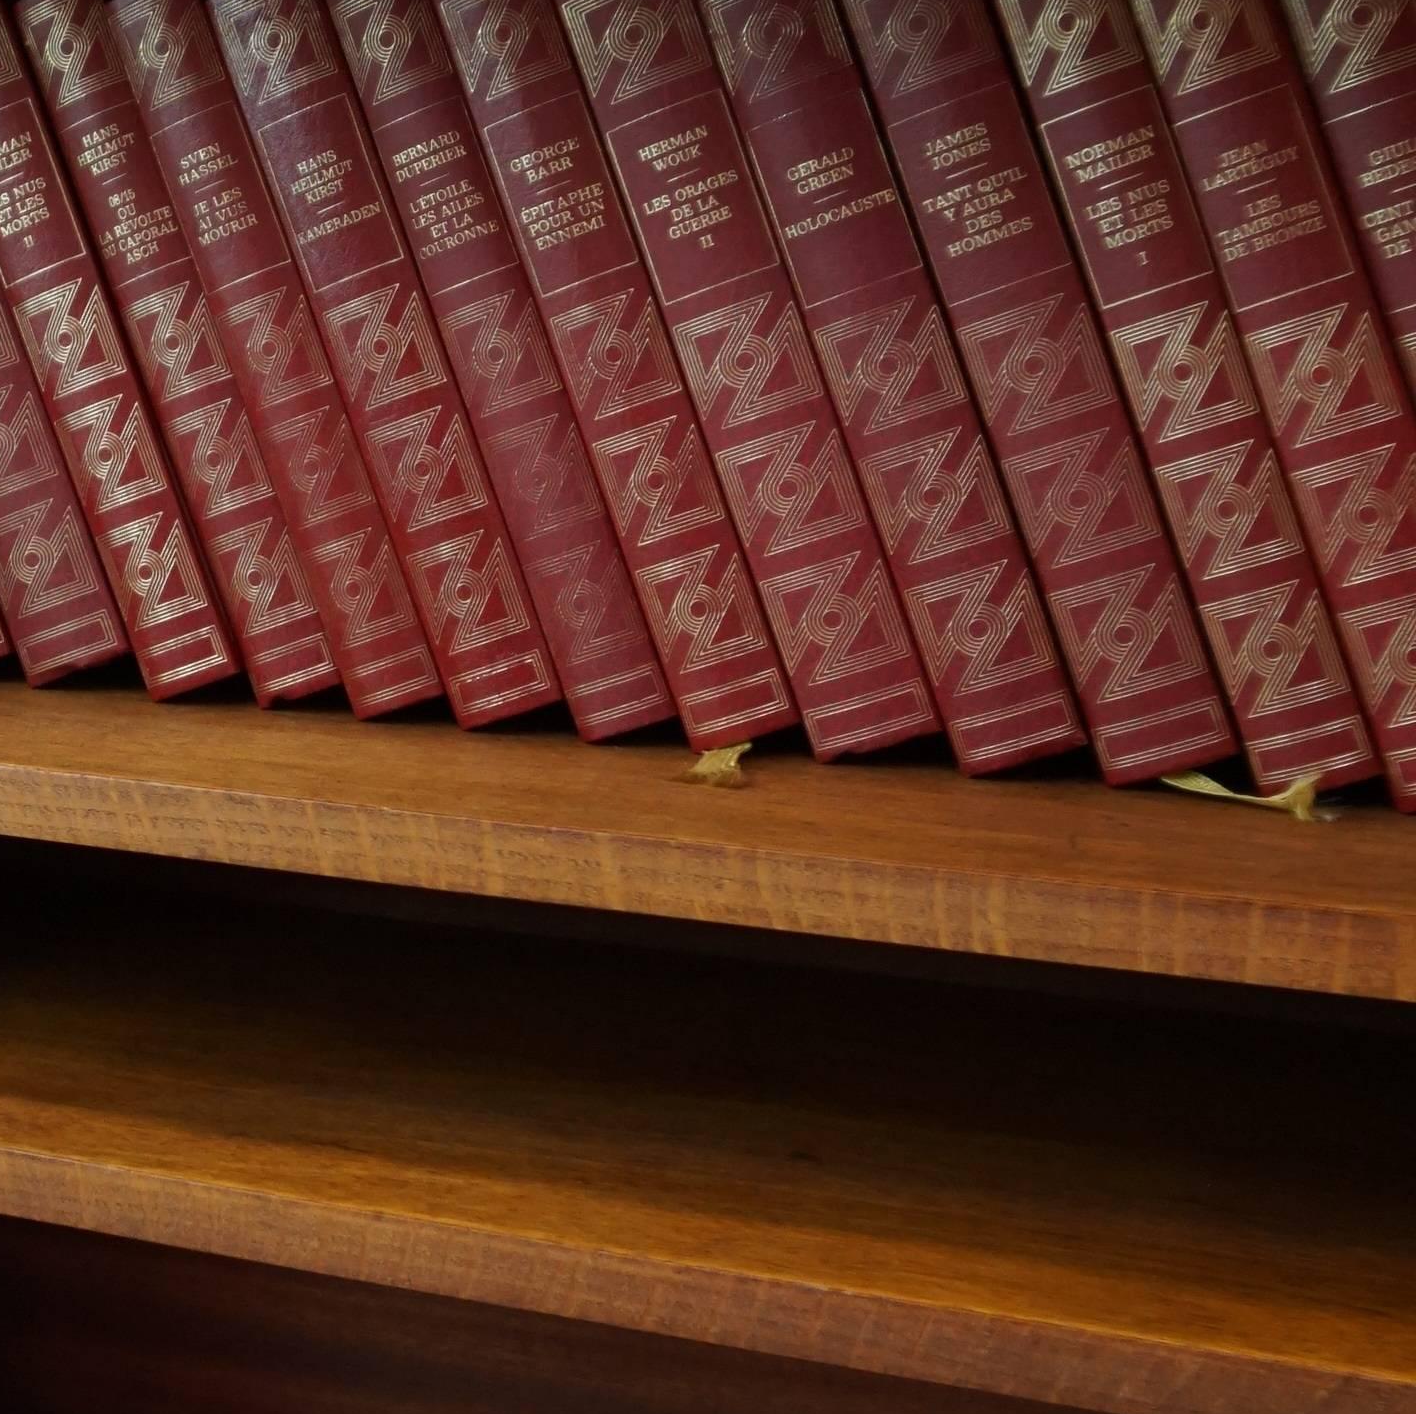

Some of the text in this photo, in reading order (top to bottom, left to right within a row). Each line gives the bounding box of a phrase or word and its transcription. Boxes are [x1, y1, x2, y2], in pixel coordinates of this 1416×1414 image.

[77, 132, 135, 167] HELLMUT
[82, 123, 120, 148] HANS
[392, 130, 460, 168] BERNARD
[638, 125, 708, 162] HERMAN
[925, 122, 988, 156] JAMES
[1064, 125, 1154, 169] NORMAN
[91, 150, 127, 175] KIRST
[180, 143, 221, 170] SVEN
[296, 149, 337, 175] HANS
[396, 145, 467, 184] DUPERIER
[510, 137, 580, 173] GEORGE
[526, 156, 573, 184] BARR
[652, 144, 702, 171] WOUK
[787, 146, 854, 181] GERALD
[932, 137, 991, 171] JONES
[1076, 144, 1155, 184] MAILER
[1202, 146, 1298, 192] LARTÉGUY
[1219, 139, 1268, 168] JEAN
[178, 154, 238, 187] HASSEL
[290, 159, 352, 195] HELLMUT
[797, 163, 854, 195] GREEN
[13, 177, 46, 200] NUS
[18, 193, 45, 214] LES
[109, 188, 136, 208] 08/15
[193, 187, 242, 218] JE LES
[305, 179, 344, 204] KIRST
[521, 182, 604, 224] ÉPITAPHE
[643, 169, 738, 215] LES ORAGES
[922, 167, 1028, 213] TANT QU'IL
[943, 188, 1016, 222] Y AURA
[1085, 179, 1170, 220] LES NUS
[0, 207, 50, 237] MORTS
[117, 202, 137, 220] OU
[198, 201, 248, 232] AI VUS
[413, 192, 485, 229] LES AILES
[529, 199, 605, 237] POUR UN
[669, 206, 732, 239] GUERRE
[671, 195, 720, 222] DE LA
[785, 188, 896, 239] HOLOCAUSTE
[965, 209, 1004, 233] DES
[1099, 198, 1168, 234] ET LES
[1217, 200, 1321, 245] TAMBOURS
[1246, 194, 1282, 218] LES
[1362, 199, 1414, 228] CENT
[99, 231, 113, 245] LA
[118, 220, 178, 252] CAPORAL
[198, 213, 259, 246] MOURIR
[297, 201, 381, 246] KAMERADEN
[419, 219, 499, 260] COURONNE
[430, 213, 474, 239] ET LA
[535, 214, 606, 251] ENNEMI
[947, 216, 1034, 258] HOMMES
[1105, 215, 1174, 249] MORTS
[1223, 215, 1327, 263] DE BRONZE
[24, 235, 34, 248] II
[126, 241, 159, 265] ASCH
[699, 234, 715, 249] II
[1138, 250, 1149, 266] I
[1384, 239, 1412, 259] DE
